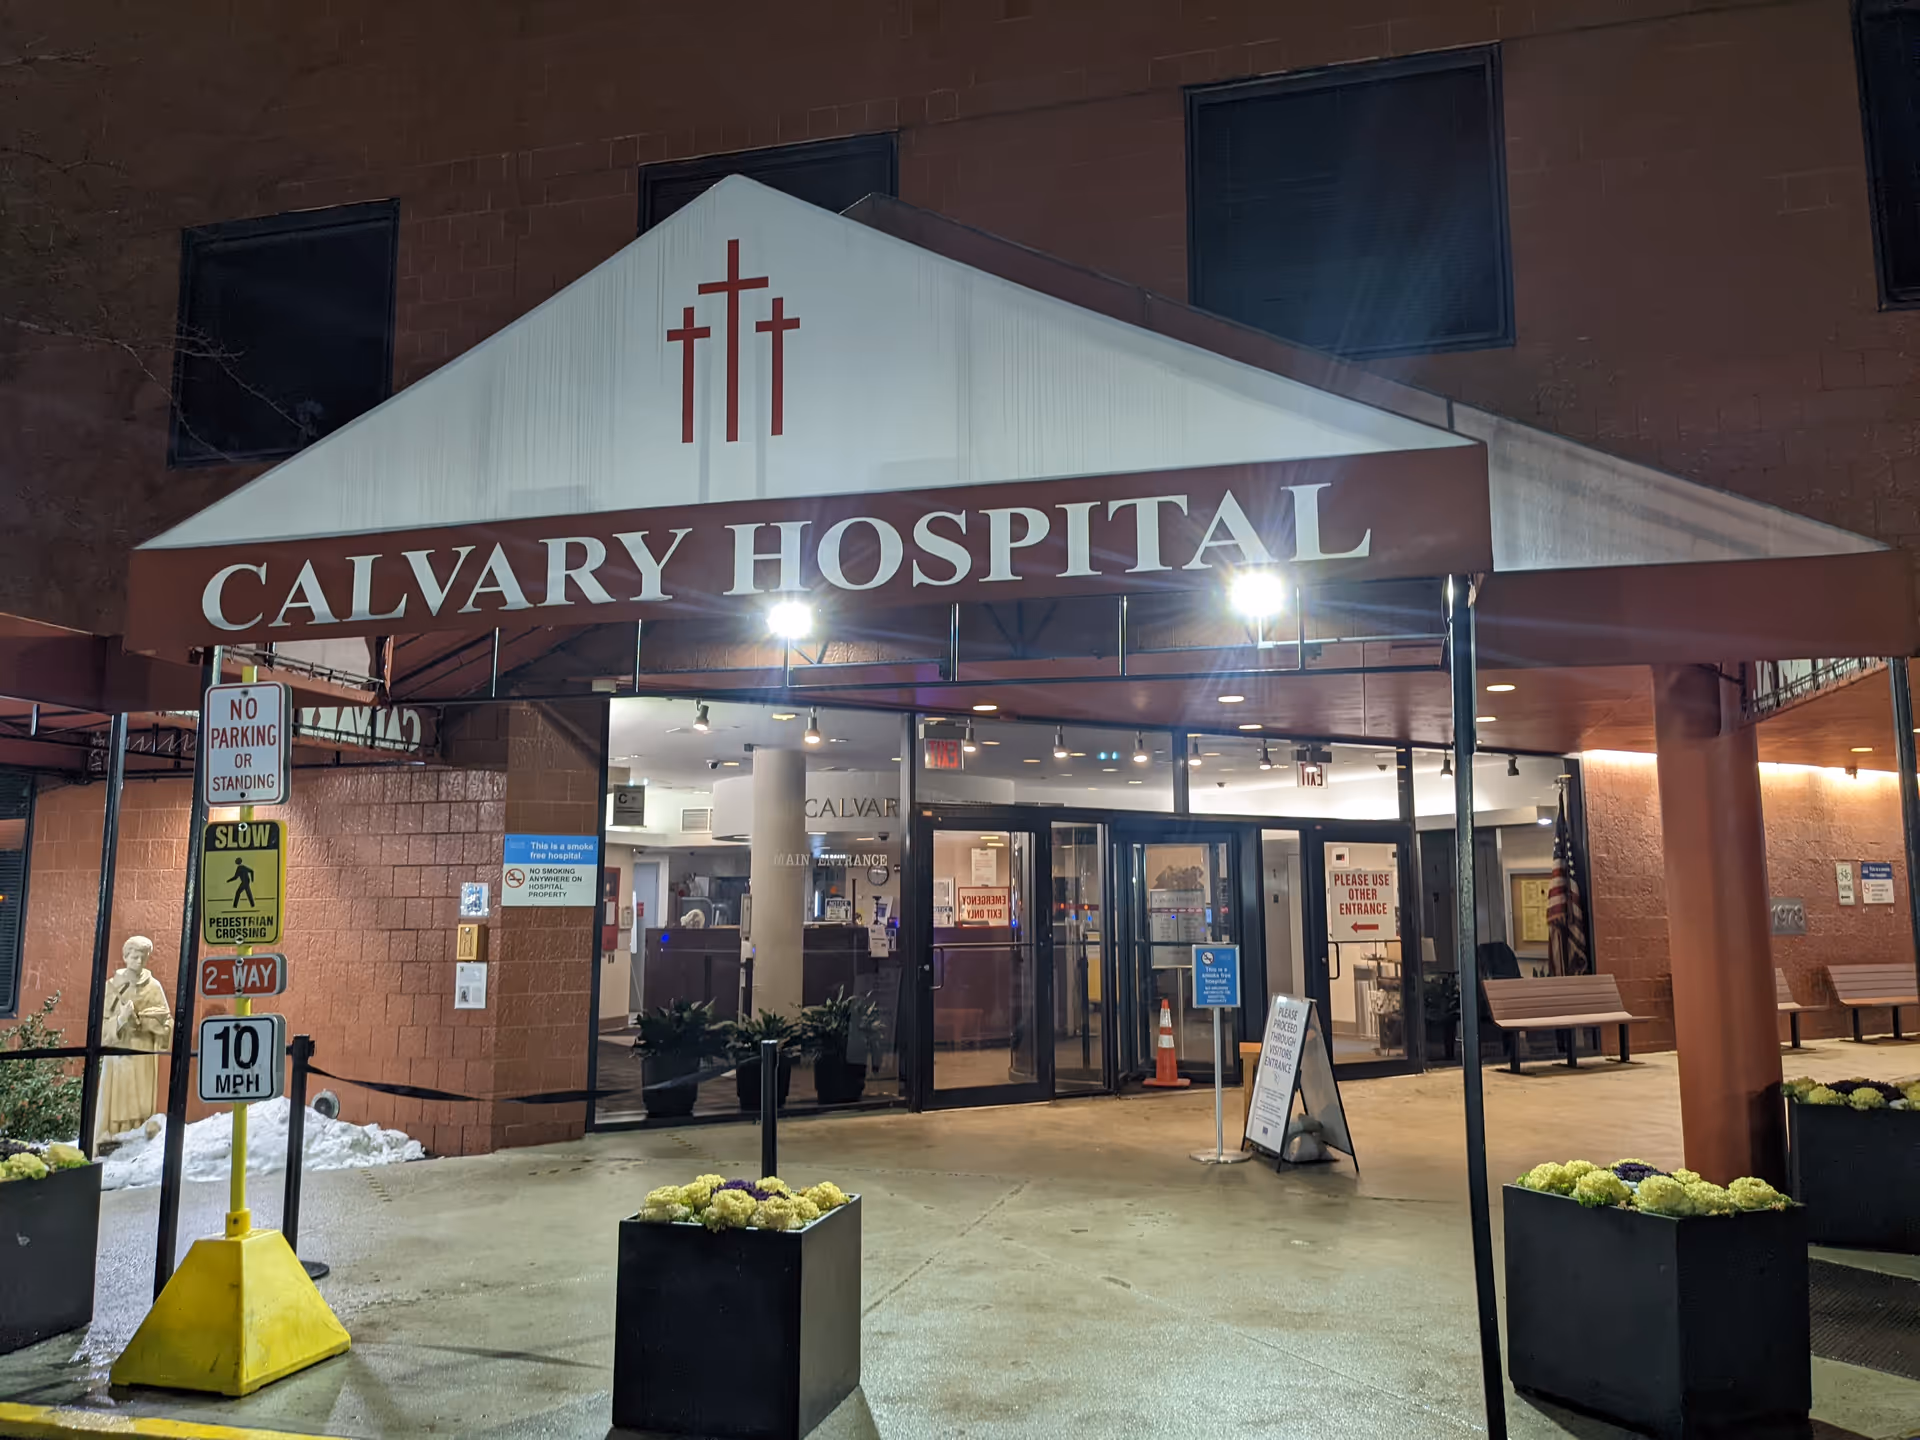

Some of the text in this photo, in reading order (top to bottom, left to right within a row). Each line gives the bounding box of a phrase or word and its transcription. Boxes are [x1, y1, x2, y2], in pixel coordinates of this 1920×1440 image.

[201, 482, 1371, 631] CALVARY HOSPITAL
[230, 697, 258, 720] NO
[211, 724, 277, 749] PARKING
[234, 753, 252, 768] OR
[212, 773, 275, 791] STANDING
[214, 824, 270, 849] SLOW
[530, 841, 548, 850] This
[550, 842, 558, 850] is
[567, 842, 594, 851] smoke
[530, 851, 546, 860] free
[774, 853, 888, 867] MAIN ENTRANCE
[1334, 873, 1389, 886] PLEASE USE
[1348, 888, 1377, 901] OTHER
[1339, 902, 1388, 916] ENTRANCE
[209, 916, 274, 928] PEDESTRIAN
[215, 927, 267, 939] CROSSING
[205, 963, 273, 990] 2-WAY
[1278, 1007, 1299, 1022] PLEASE
[1272, 1018, 1298, 1034] PROCEED
[213, 1025, 260, 1070] 10
[1270, 1031, 1297, 1048] THROUGH
[1269, 1044, 1293, 1060] VISITORS
[1264, 1056, 1292, 1075] ENTRANCE
[215, 1073, 260, 1094] MPH
